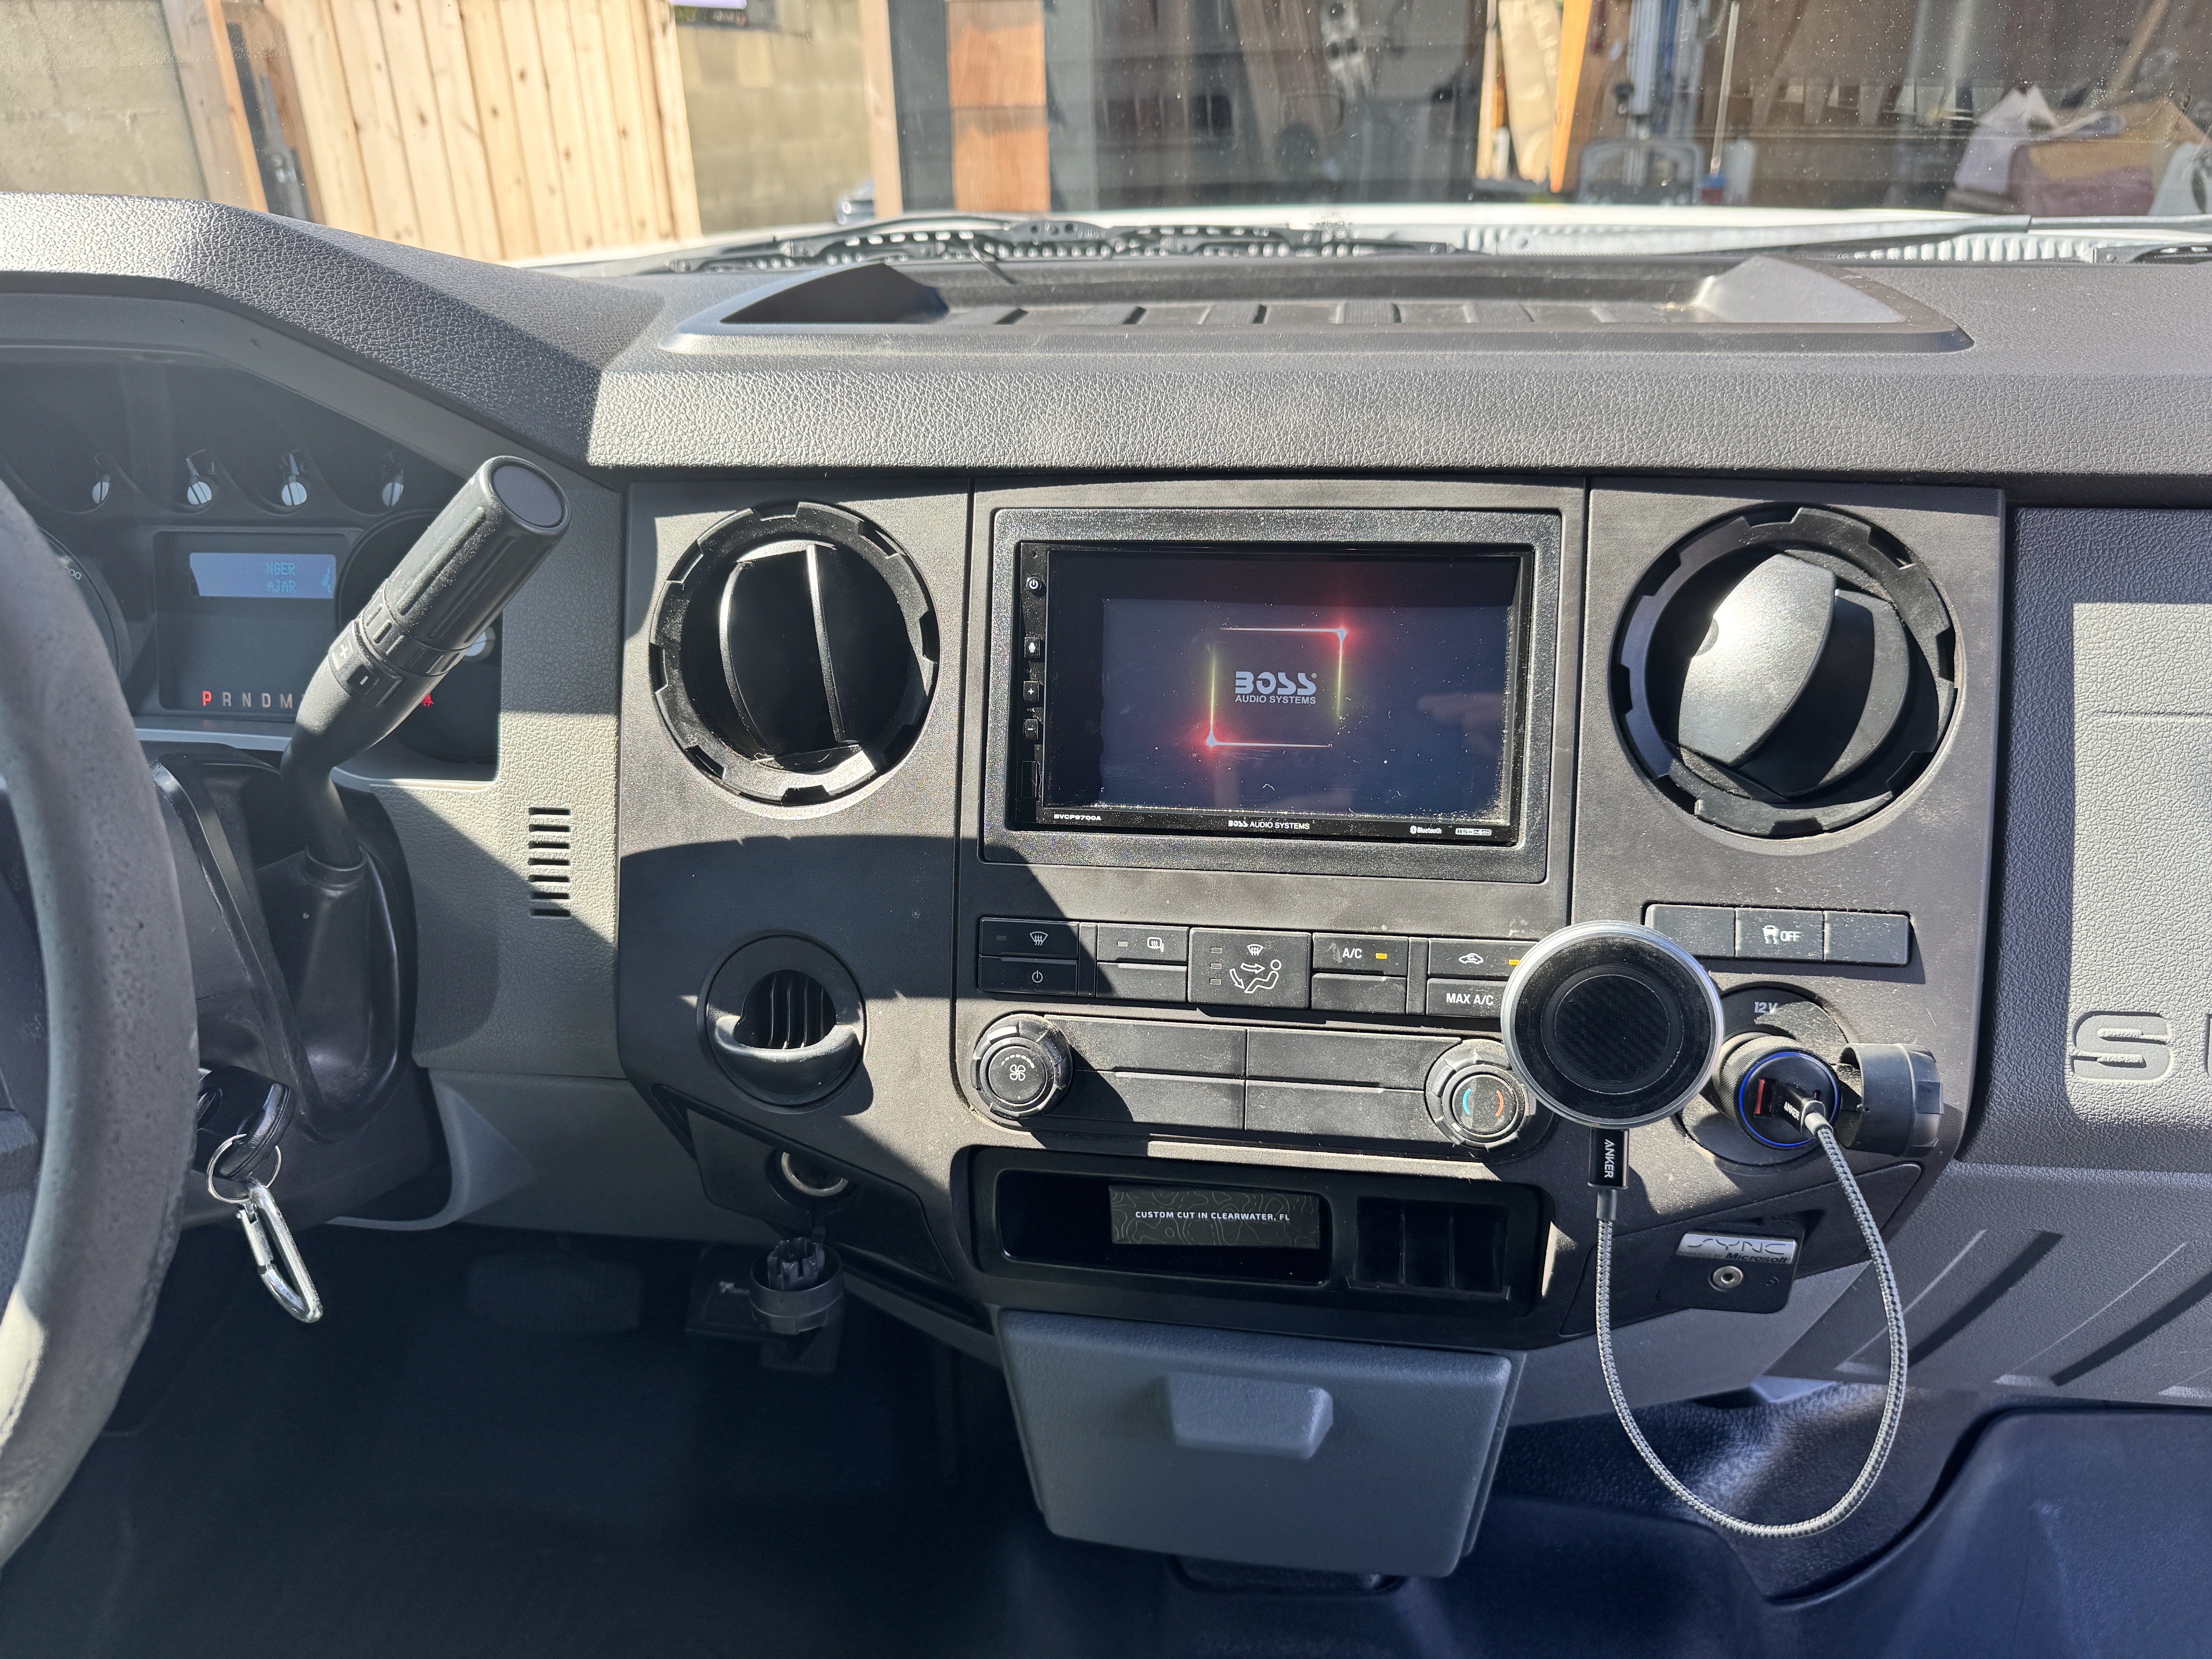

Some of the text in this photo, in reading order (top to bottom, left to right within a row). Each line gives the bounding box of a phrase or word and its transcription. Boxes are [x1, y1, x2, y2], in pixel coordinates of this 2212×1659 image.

[1235, 671, 1317, 696] BOSS
[1235, 695, 1316, 704] AUDIO SYSTEMS
[1274, 822, 1310, 830] SYSTEMS
[1780, 930, 1802, 942] OFF
[1342, 947, 1362, 959] A/C
[1446, 993, 1494, 1006] MAX A/C
[1783, 1101, 1801, 1121] ANKER
[1604, 1139, 1614, 1178] ANKER
[1211, 1212, 1276, 1221] CLEARWATER,
[1687, 1238, 1786, 1255] SYNC
[1725, 1252, 1788, 1263] Microsoft
